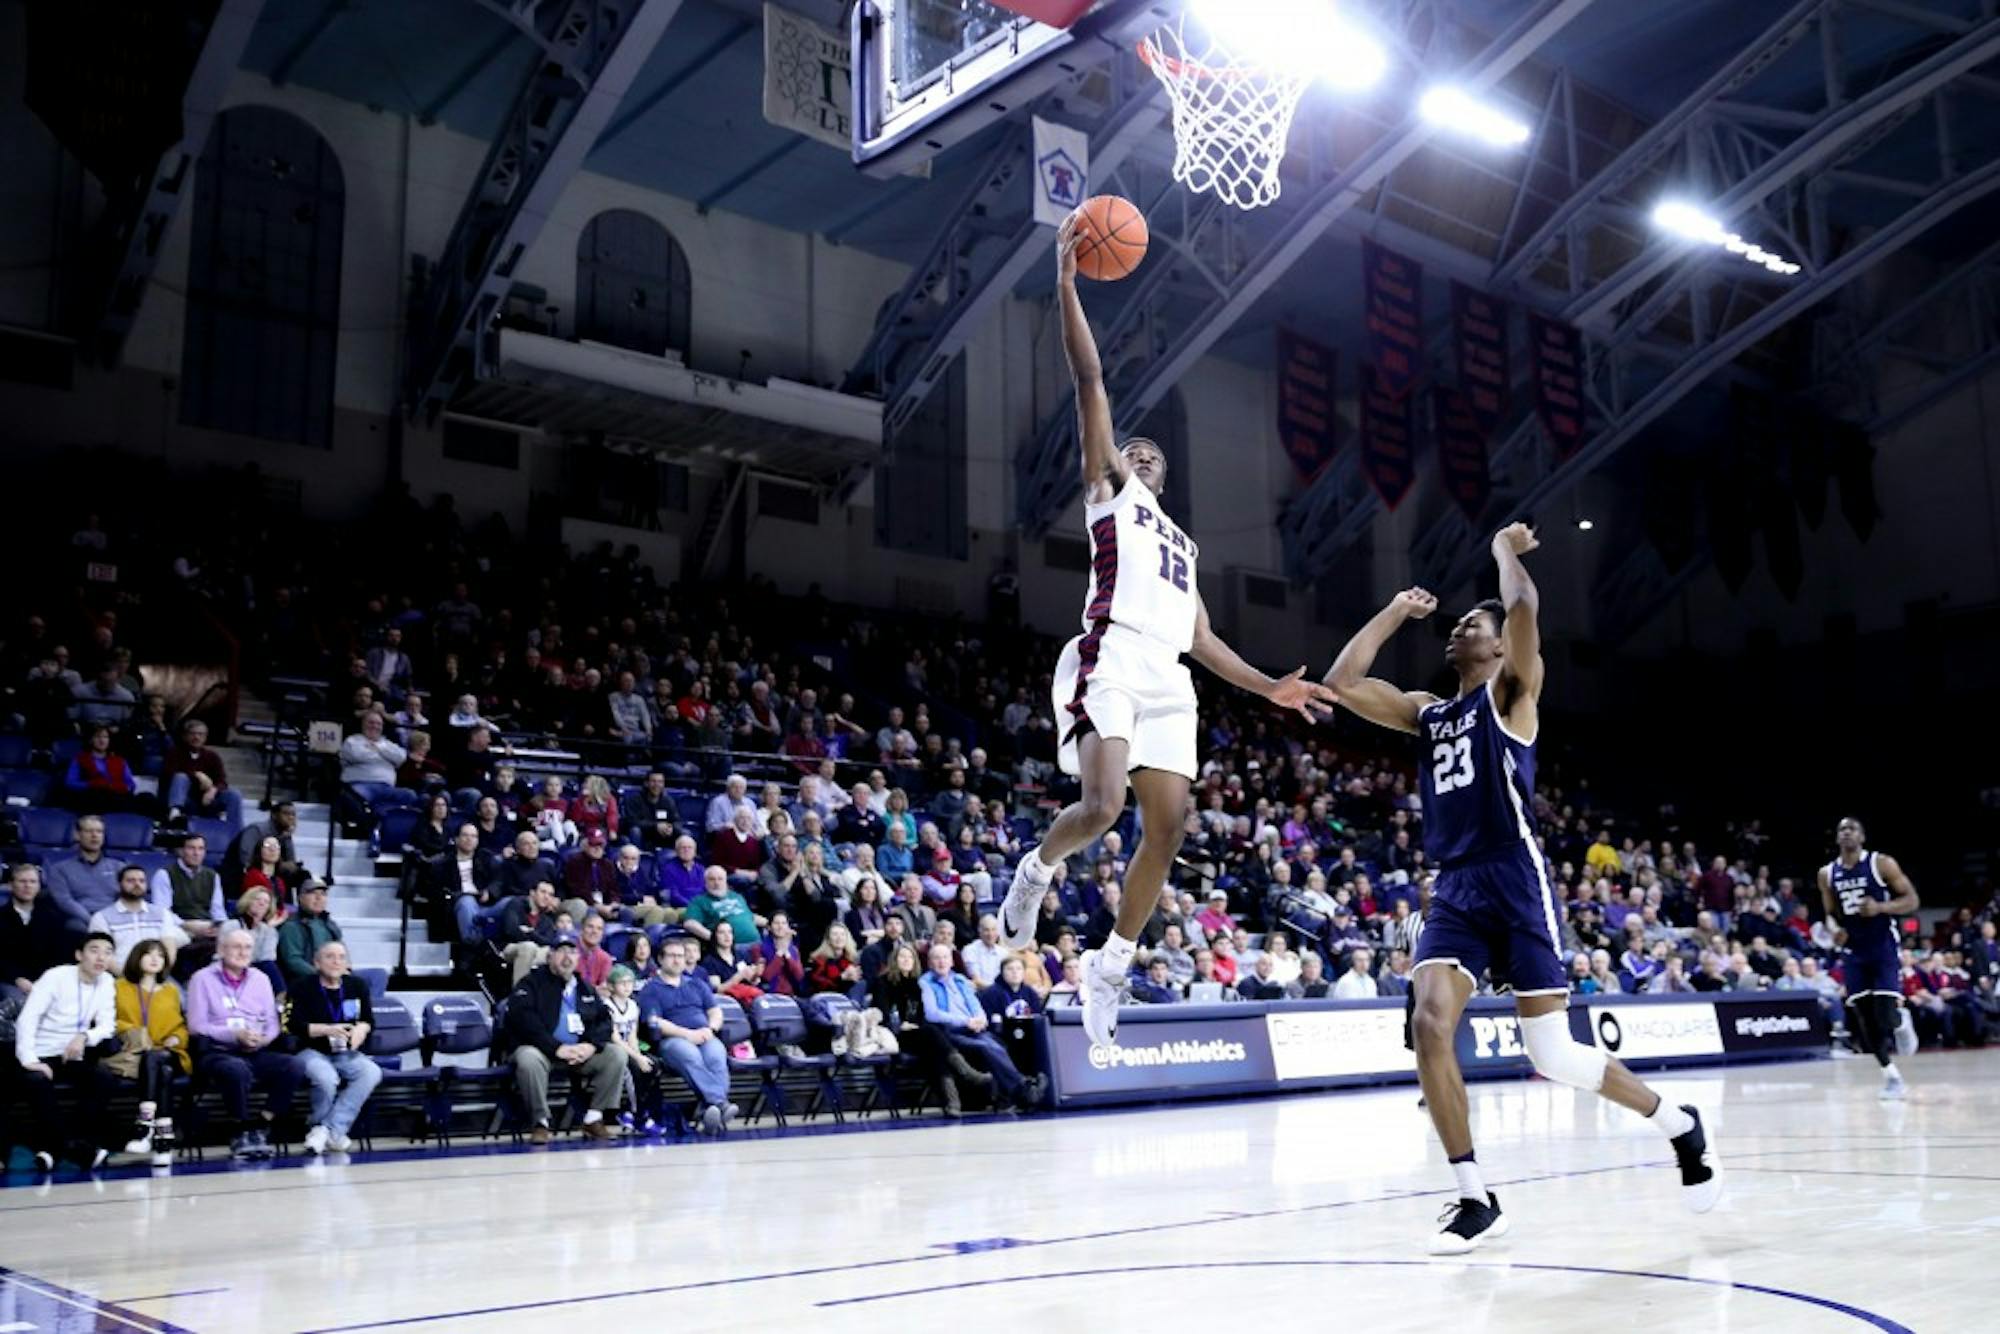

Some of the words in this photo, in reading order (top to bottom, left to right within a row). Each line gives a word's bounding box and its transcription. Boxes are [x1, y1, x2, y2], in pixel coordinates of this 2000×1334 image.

[1158, 542, 1189, 594] 12
[1429, 709, 1477, 740] YALE
[1433, 735, 1475, 795] 23
[1834, 877, 1868, 891] YALE
[1088, 1038, 1247, 1070] @PennAthletics
[1469, 1015, 1529, 1058] PE
